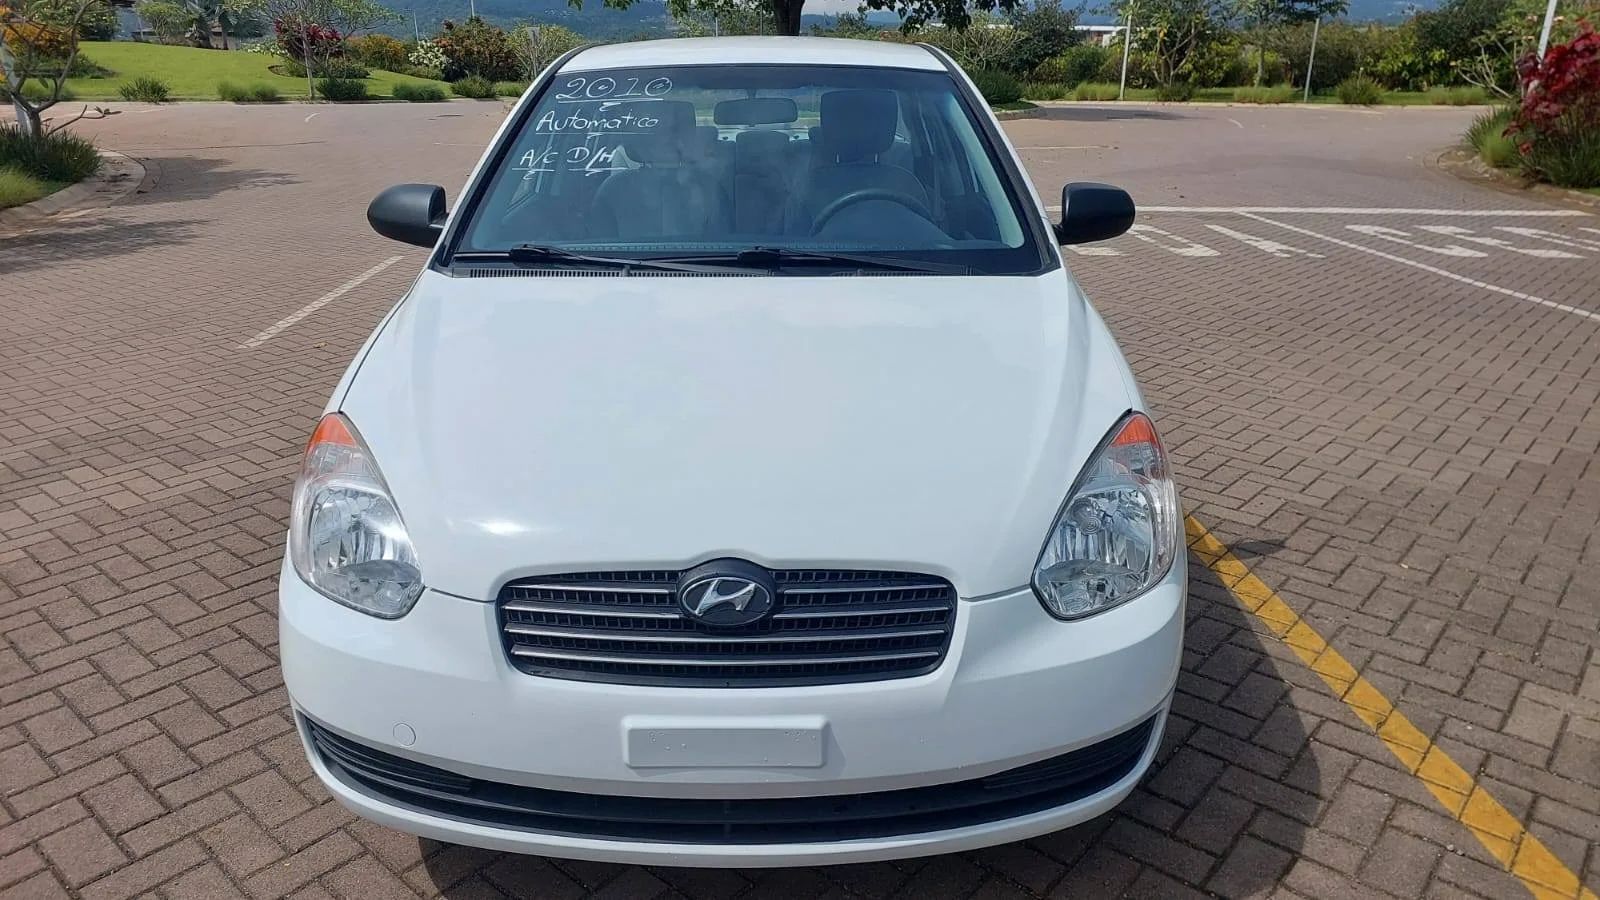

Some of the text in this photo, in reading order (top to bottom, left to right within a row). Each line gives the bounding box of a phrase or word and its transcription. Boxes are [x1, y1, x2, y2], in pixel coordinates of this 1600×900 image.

[556, 77, 673, 99] 2010
[536, 109, 660, 131] Automatico
[519, 146, 559, 169] A/C
